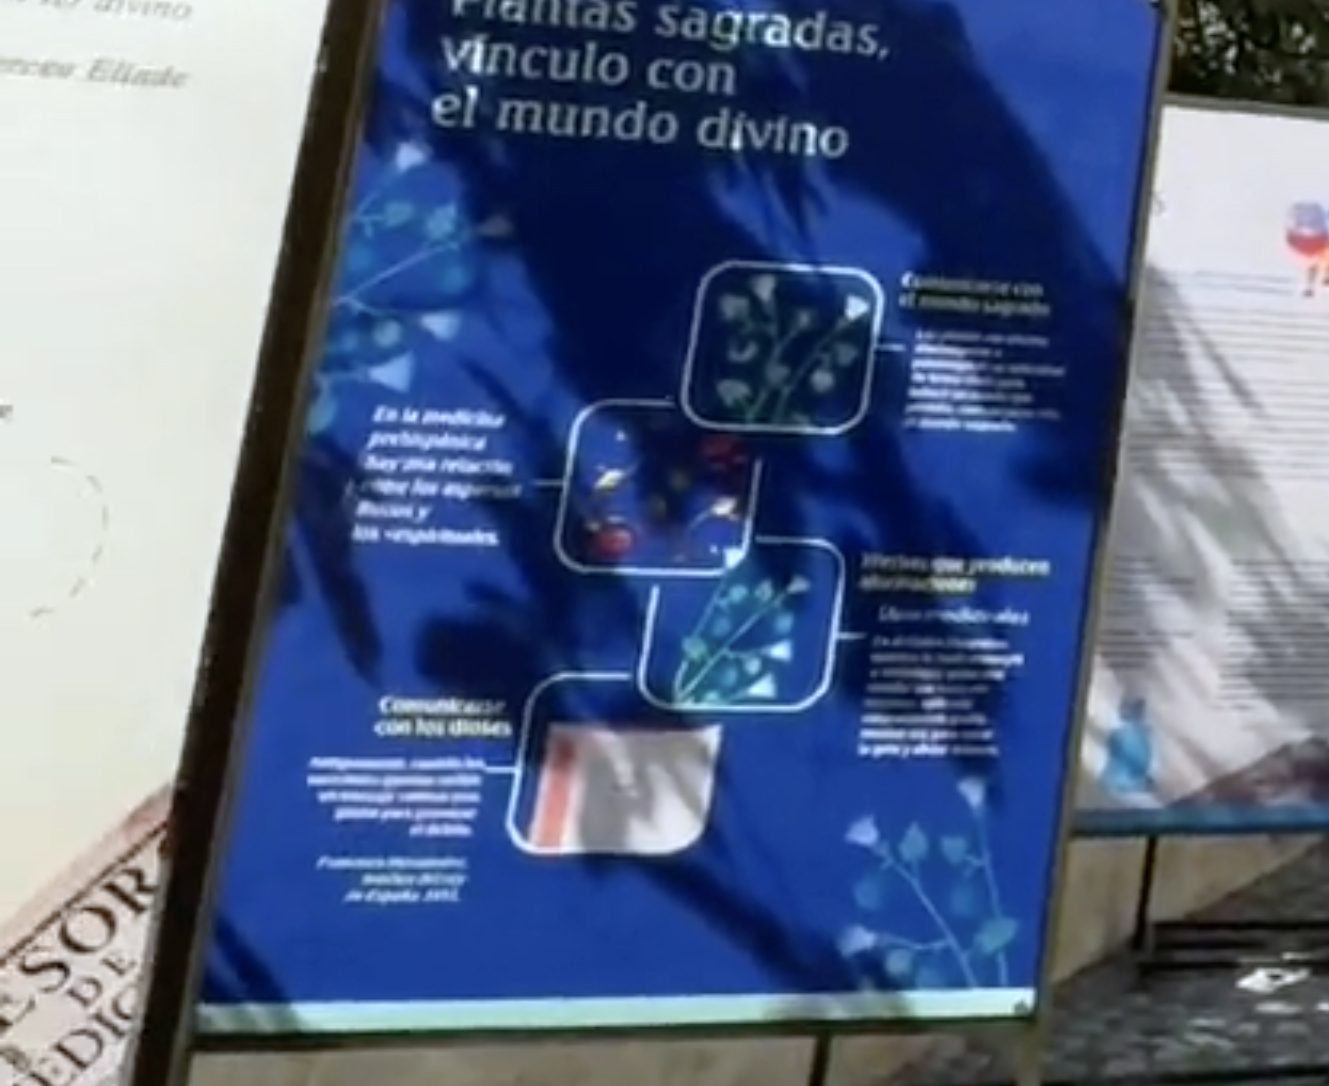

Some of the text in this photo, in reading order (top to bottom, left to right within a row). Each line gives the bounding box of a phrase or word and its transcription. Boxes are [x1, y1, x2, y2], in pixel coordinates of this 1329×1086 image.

[654, 1, 892, 61] sagradas,
[440, 33, 738, 98] vínculo con
[431, 83, 850, 160] el mundo divino
[373, 719, 412, 738] con
